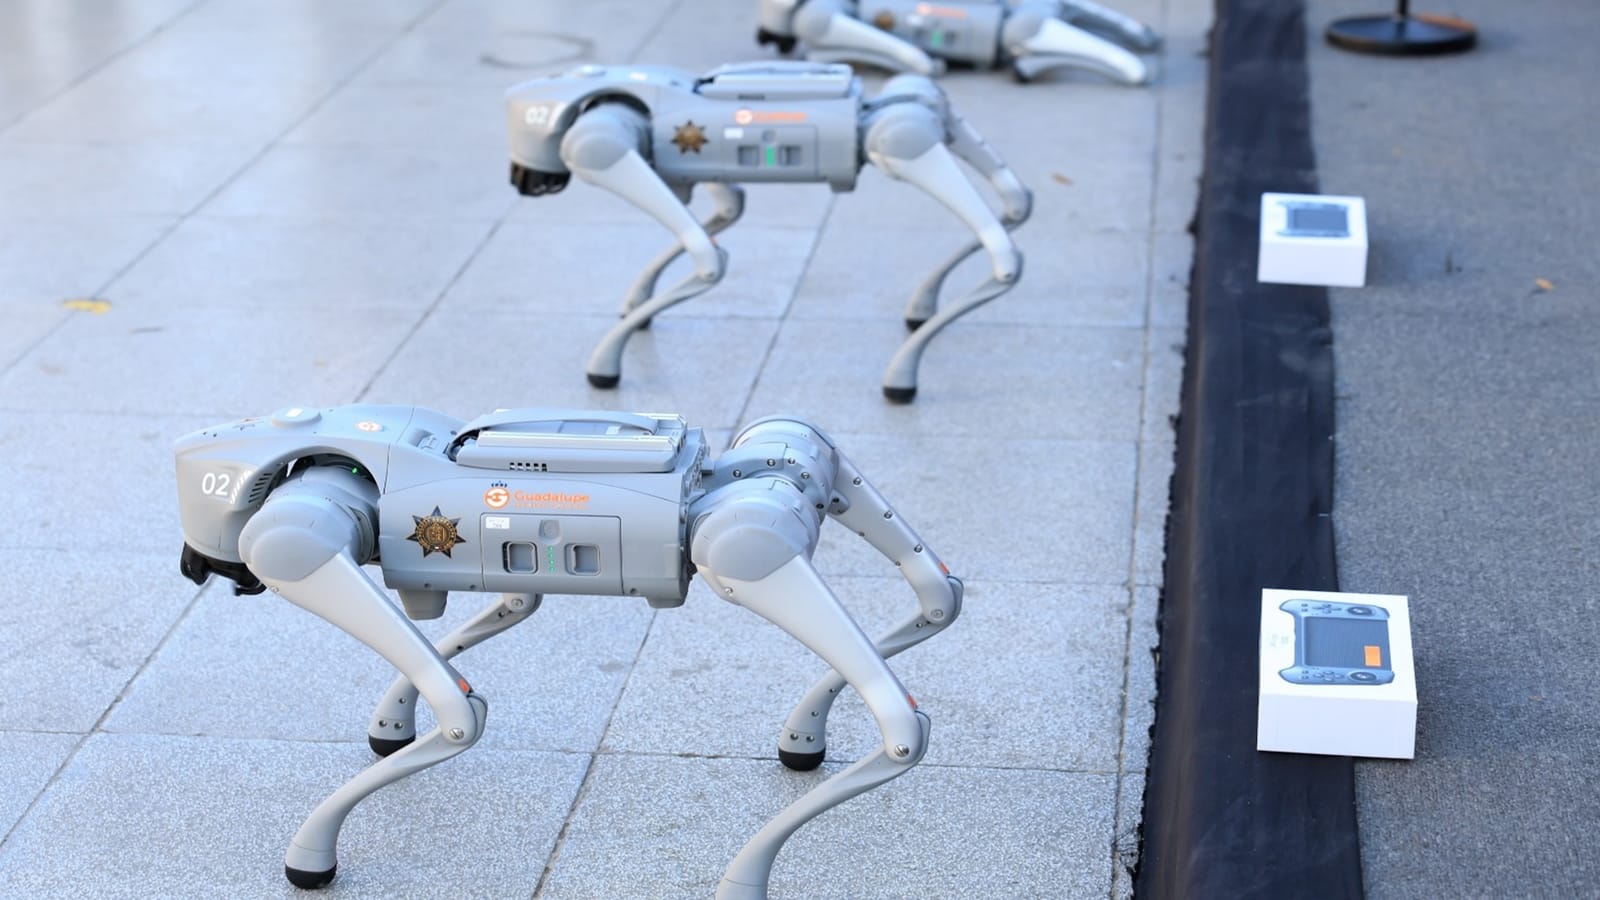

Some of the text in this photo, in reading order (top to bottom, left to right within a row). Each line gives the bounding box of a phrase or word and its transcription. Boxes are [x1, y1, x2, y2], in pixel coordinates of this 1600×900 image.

[525, 106, 549, 125] 02
[201, 472, 230, 496] 02
[514, 489, 590, 504] Guadalupe
